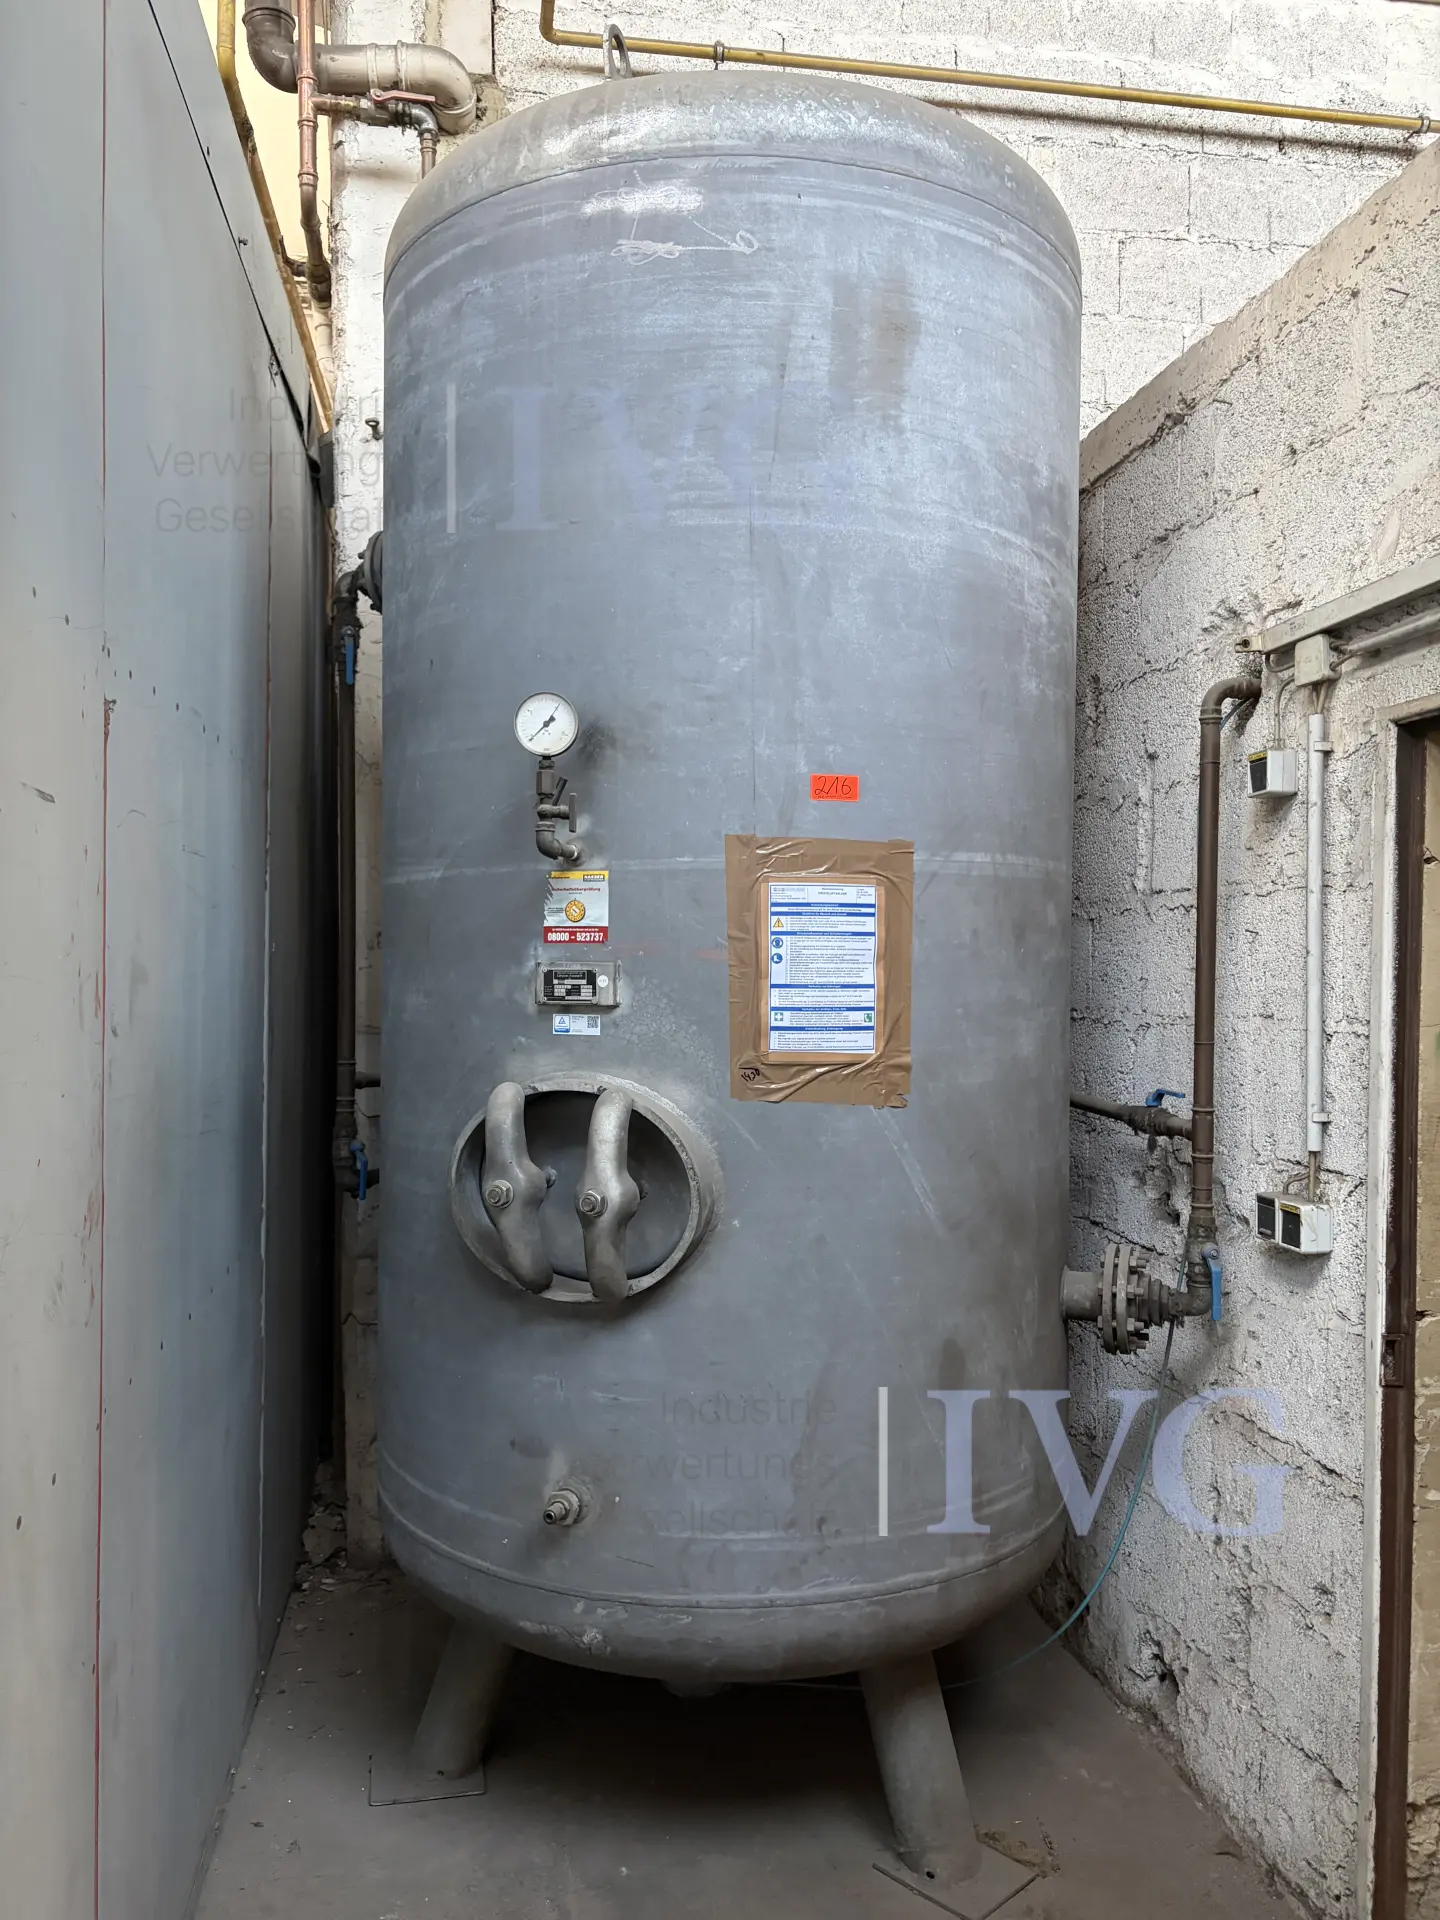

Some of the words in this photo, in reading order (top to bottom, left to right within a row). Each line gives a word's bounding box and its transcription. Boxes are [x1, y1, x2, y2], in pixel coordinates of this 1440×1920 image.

[814, 775, 852, 796] 216
[547, 932, 570, 942] 08000
[576, 932, 604, 942] 523737
